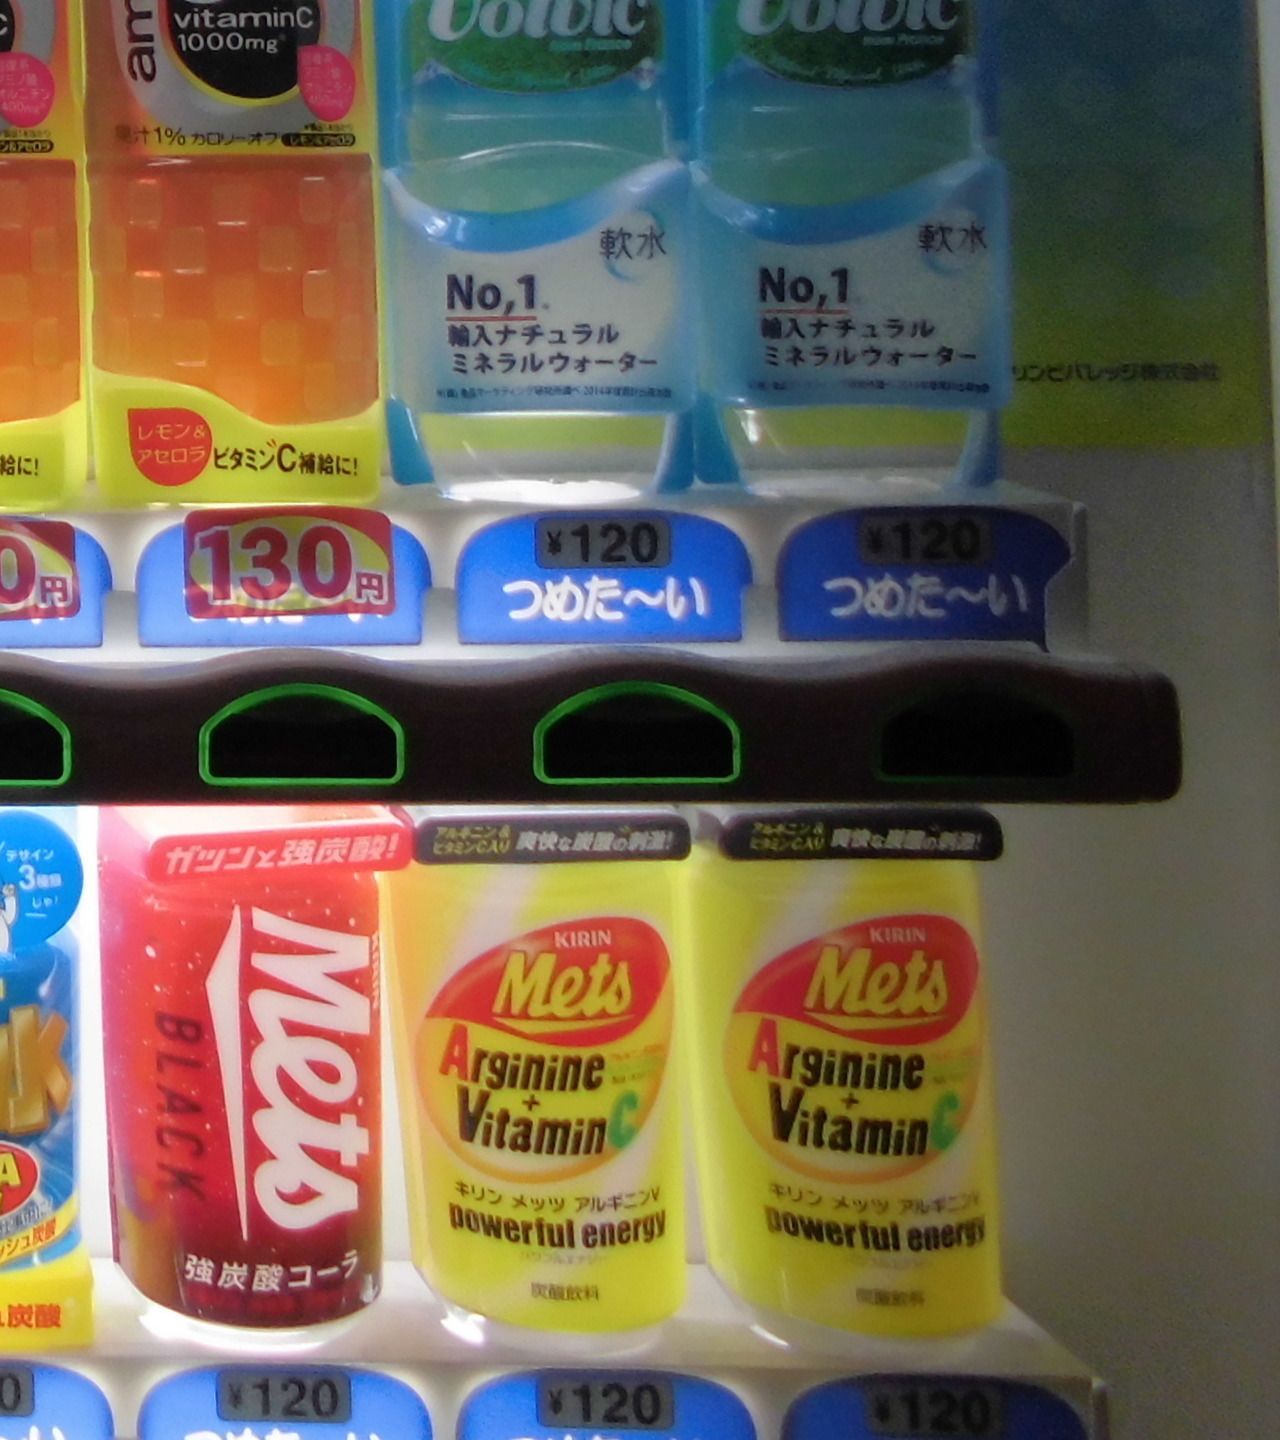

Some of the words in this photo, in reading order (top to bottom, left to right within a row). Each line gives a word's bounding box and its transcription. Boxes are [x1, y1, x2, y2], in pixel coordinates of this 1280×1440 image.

[600, 228, 668, 259] 軟水
[918, 222, 986, 252] 軟水
[452, 352, 658, 375] ミネラルウォーター
[548, 522, 658, 564] ¥120
[866, 520, 980, 558] ¥120
[196, 526, 388, 602] 130円
[554, 930, 611, 948] KIRIN
[869, 927, 925, 944] KIRIN
[493, 951, 634, 1019] Mets
[804, 948, 949, 1017] Mets
[248, 906, 374, 1230] Mets
[439, 1024, 606, 1092] Arginine
[748, 1020, 924, 1091] Arginine
[155, 1010, 205, 1202] BLACK
[449, 1203, 575, 1248] powerful
[581, 1207, 667, 1248] energy
[765, 1204, 901, 1250] powerful
[907, 1216, 985, 1250] energy
[185, 1254, 359, 1293] 強炭酸コーラ
[547, 1385, 662, 1425] ¥120
